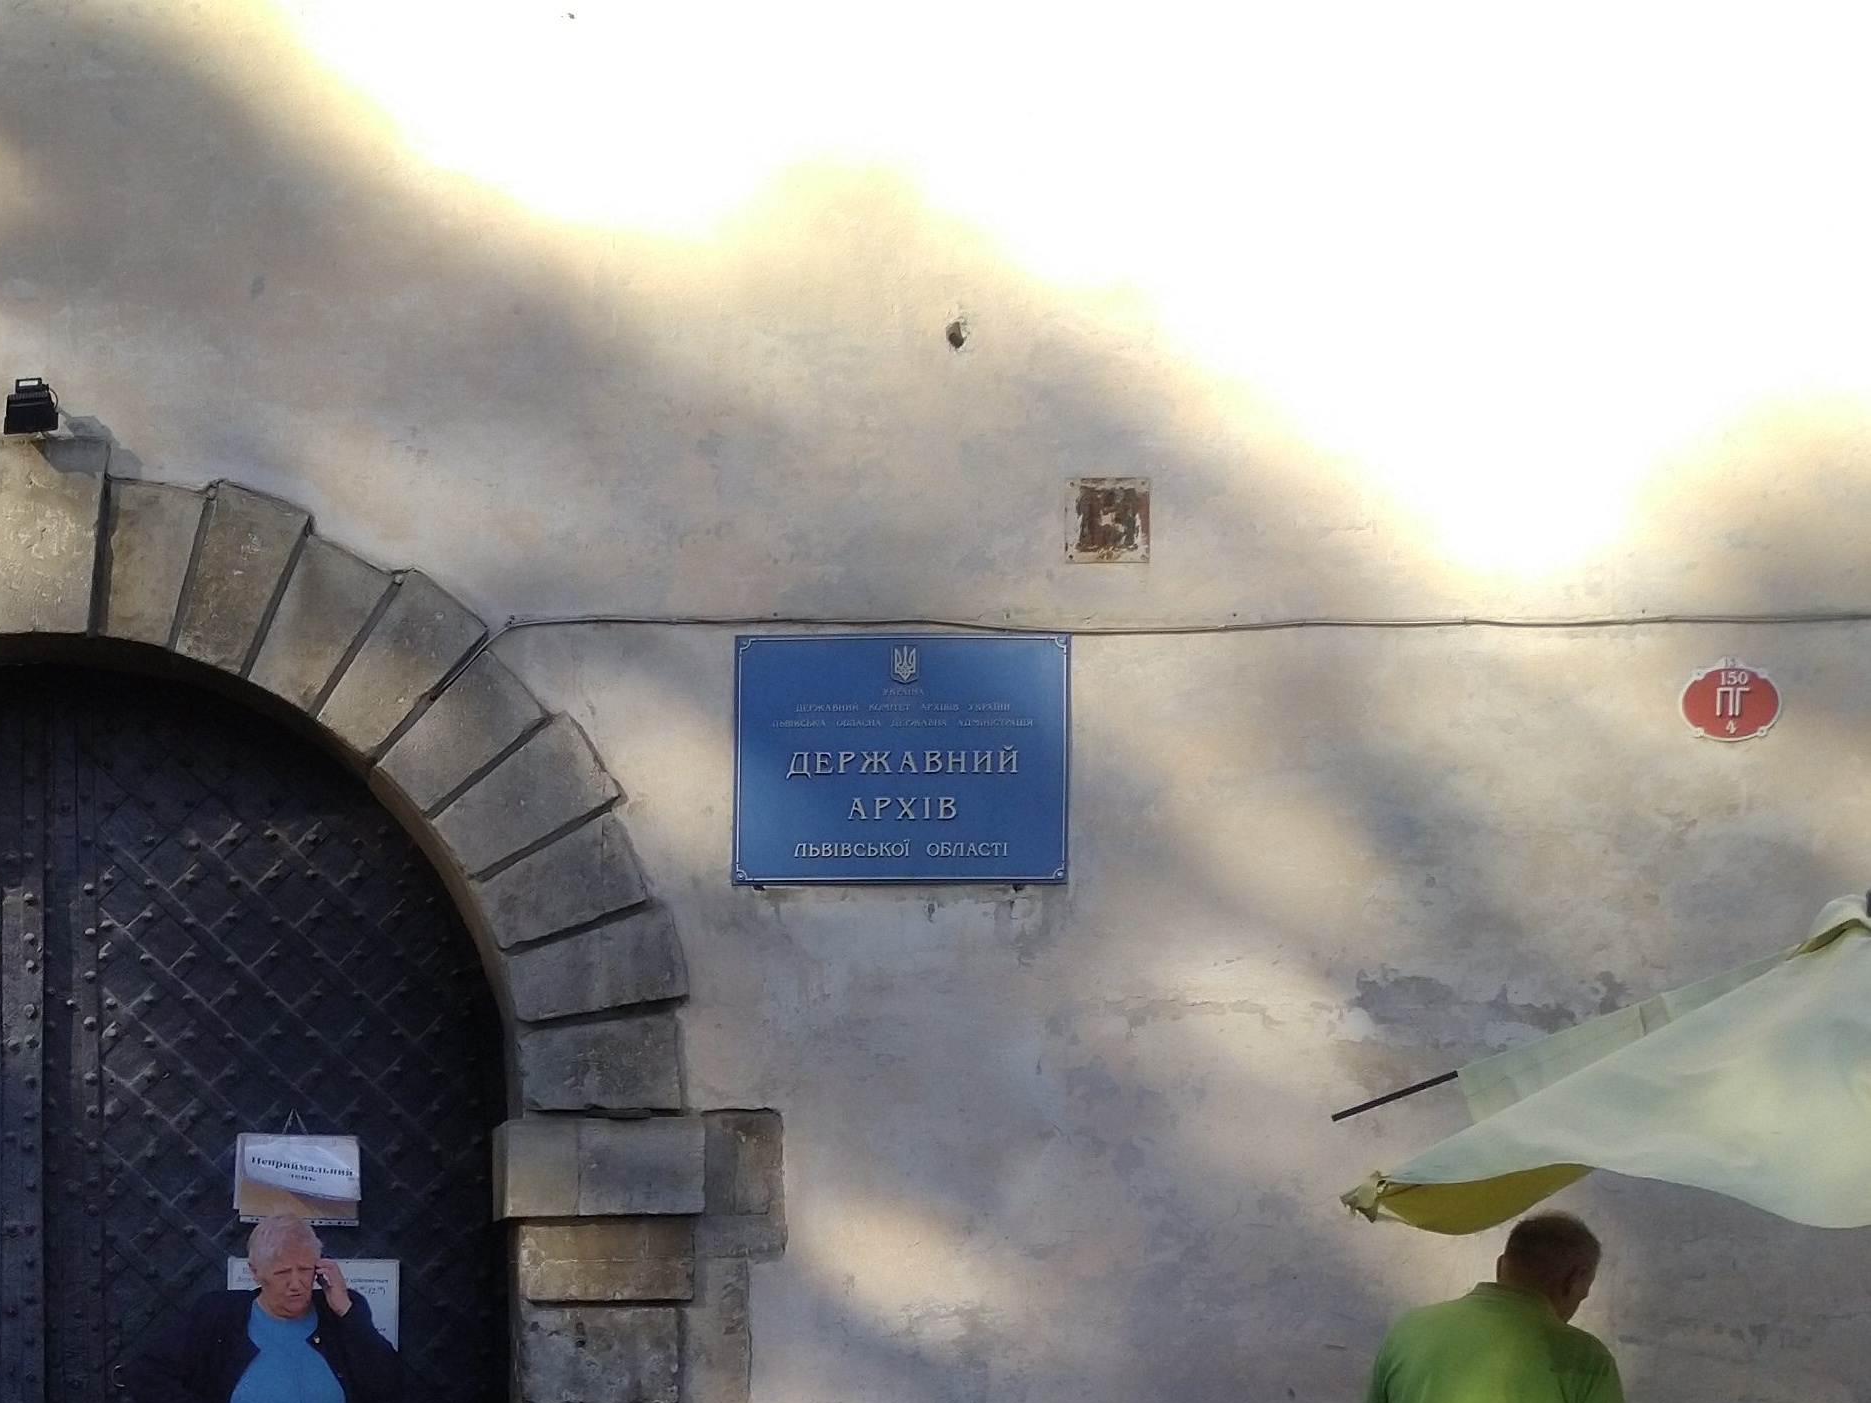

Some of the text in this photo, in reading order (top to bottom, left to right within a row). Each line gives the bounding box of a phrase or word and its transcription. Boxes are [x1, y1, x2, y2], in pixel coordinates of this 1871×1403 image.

[1720, 671, 1748, 685] 150
[1716, 687, 1750, 716] ПГ
[1725, 719, 1738, 734] 4
[786, 744, 1019, 779] ДЕРЖАВНИЙ
[848, 796, 958, 821] АРХІВ
[793, 838, 1009, 858] ЛЬВІВСЬКОЇ ОБЛАСТІ
